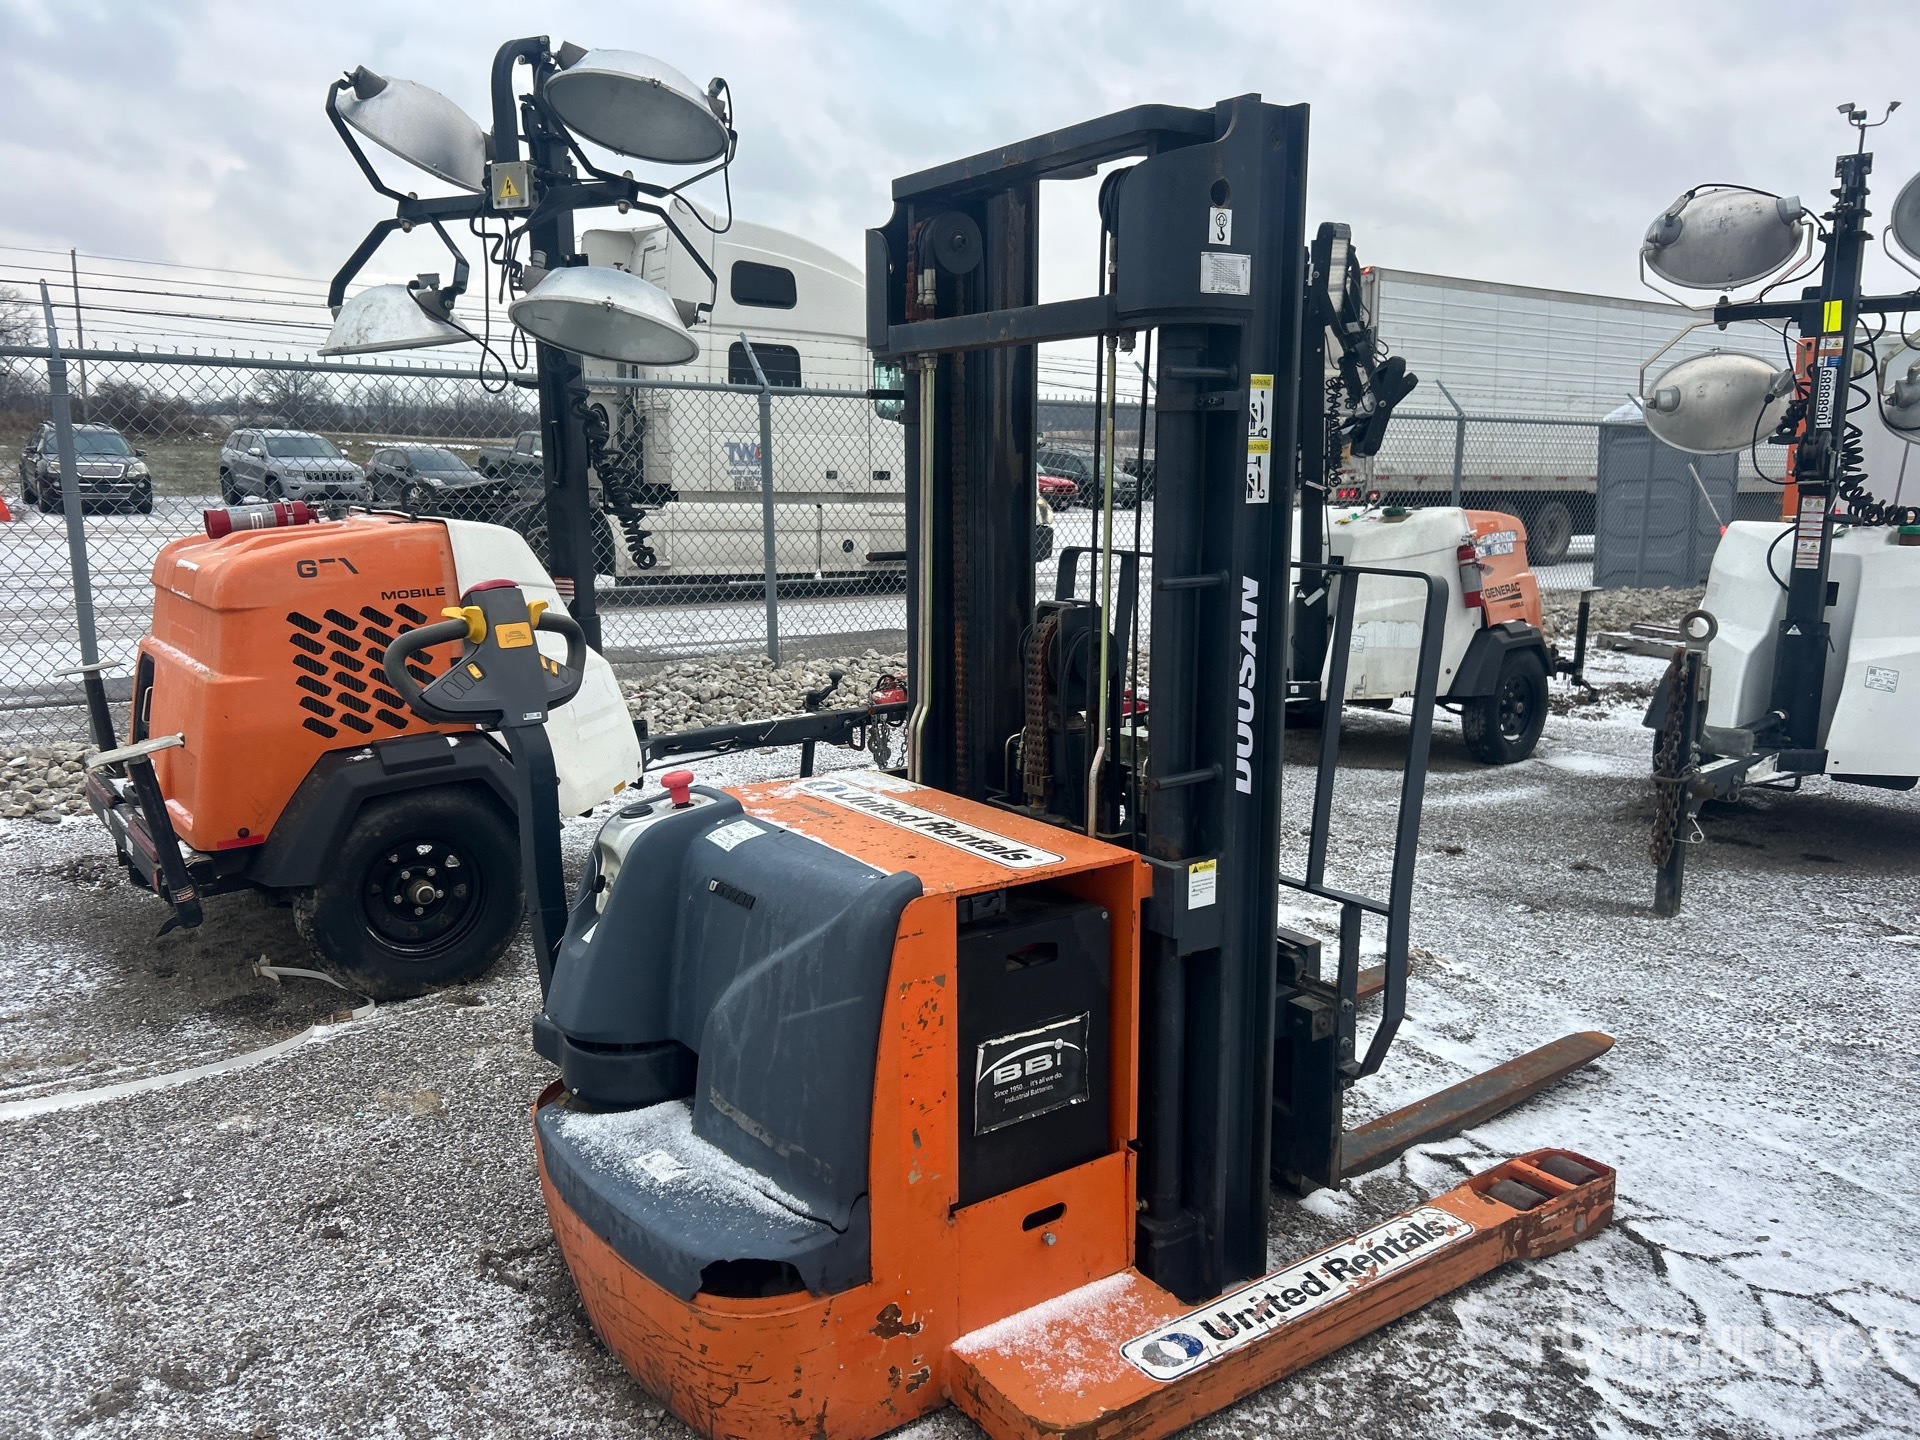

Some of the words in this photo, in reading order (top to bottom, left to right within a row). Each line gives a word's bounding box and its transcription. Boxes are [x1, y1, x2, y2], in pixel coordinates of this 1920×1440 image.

[1816, 369, 1832, 427] 10688889
[381, 587, 445, 600] MOBILE
[1485, 582, 1521, 599] GENERAC
[835, 792, 931, 822] United
[914, 821, 1032, 862] Rentals
[993, 1089, 1009, 1099] Since
[1004, 1090, 1030, 1104] Industrial
[1030, 1084, 1054, 1096] Batteries
[1198, 1270, 1331, 1342] United
[1325, 1219, 1447, 1282] Rentals
